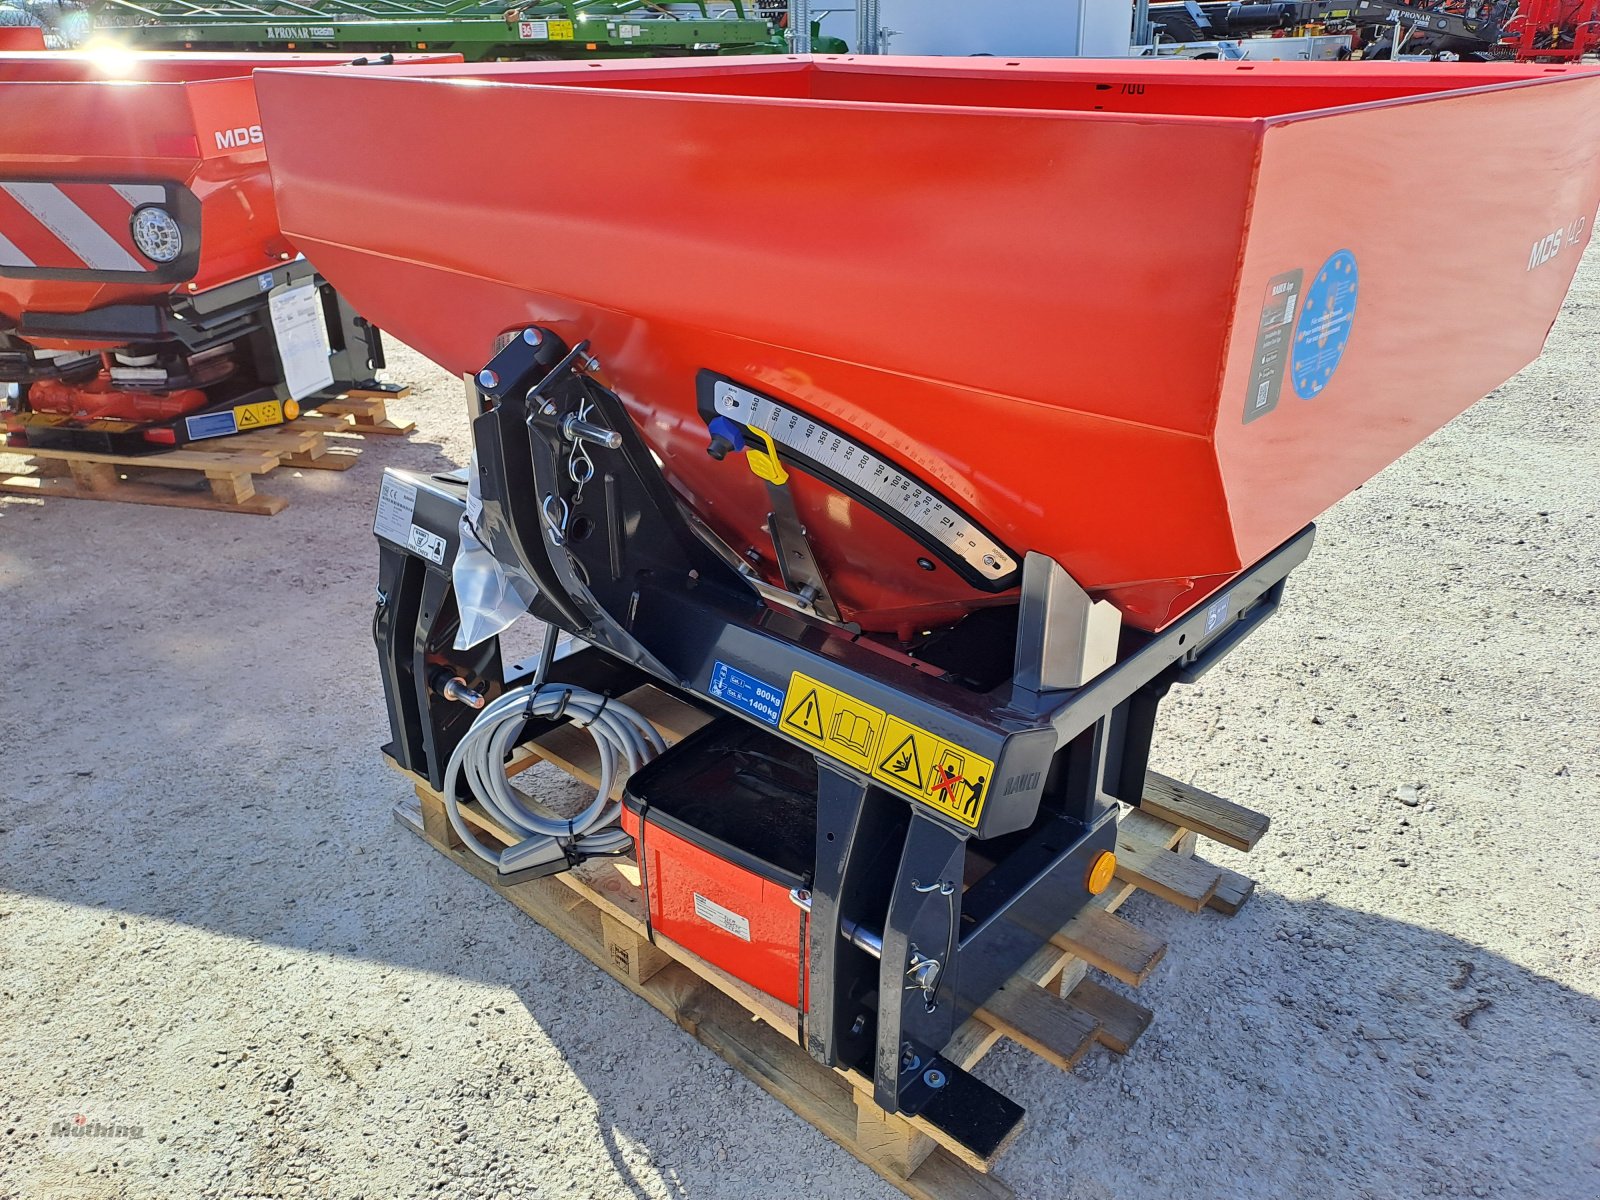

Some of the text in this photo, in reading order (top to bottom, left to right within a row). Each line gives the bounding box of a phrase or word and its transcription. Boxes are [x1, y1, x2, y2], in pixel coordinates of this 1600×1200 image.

[1400, 10, 1430, 21] PRONAR
[274, 27, 309, 38] PRONAR
[214, 125, 264, 150] MDS
[1526, 228, 1563, 271] MDS
[750, 397, 760, 412] 550
[771, 407, 782, 422] 500
[788, 415, 799, 430] 450
[805, 424, 816, 439] 400
[817, 431, 829, 446] 350
[829, 438, 842, 453] 300
[843, 446, 855, 460] 250
[857, 454, 870, 469] 200
[873, 464, 885, 477] 150
[890, 474, 902, 488] 100
[900, 480, 911, 491] 80
[912, 488, 922, 499] 50
[922, 495, 933, 506] 30
[933, 502, 943, 512] 15
[939, 516, 951, 526] 10
[968, 540, 977, 548] 0
[913, 500, 921, 509] 40
[923, 507, 931, 516] 20
